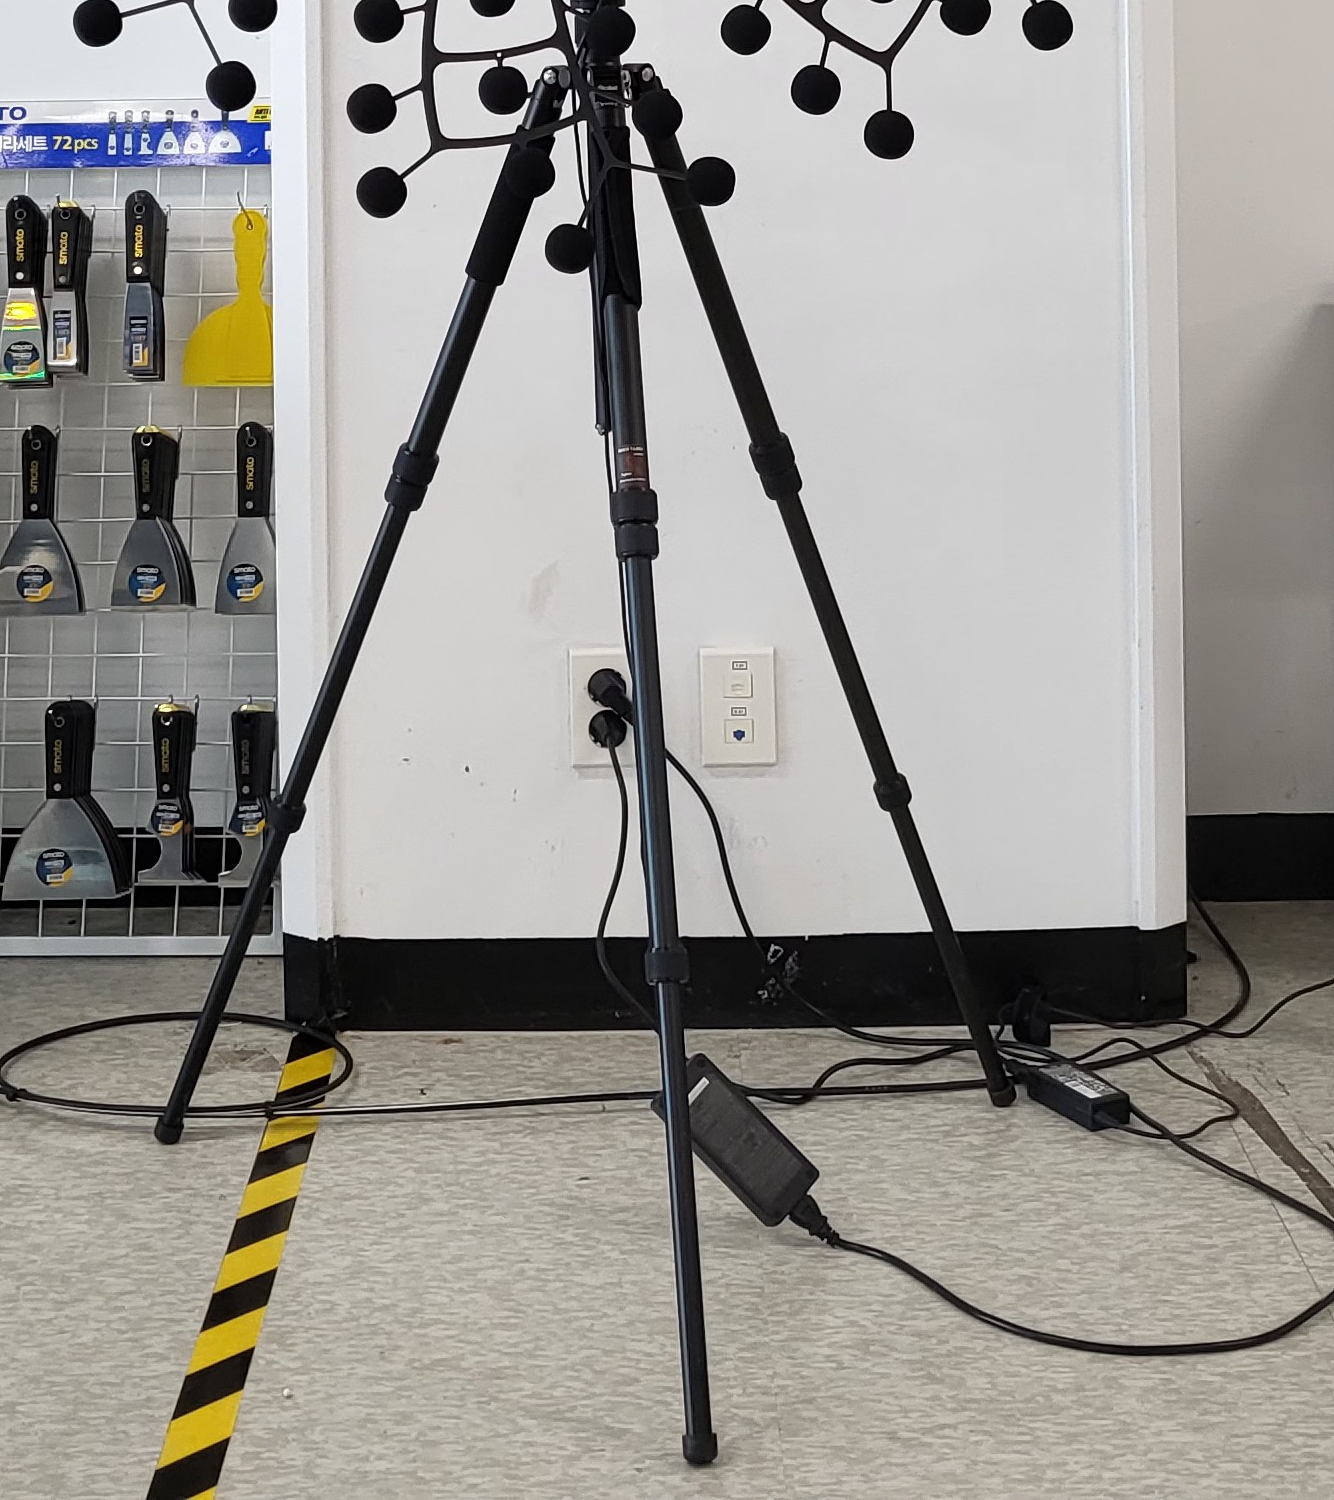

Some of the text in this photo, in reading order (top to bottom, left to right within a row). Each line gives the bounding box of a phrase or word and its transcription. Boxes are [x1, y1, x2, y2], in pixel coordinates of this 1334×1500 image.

[16, 228, 25, 262] smato
[59, 231, 68, 265] smato
[135, 224, 144, 258] smato
[30, 460, 39, 494] smato
[246, 457, 255, 490] smato
[53, 739, 62, 774] smato
